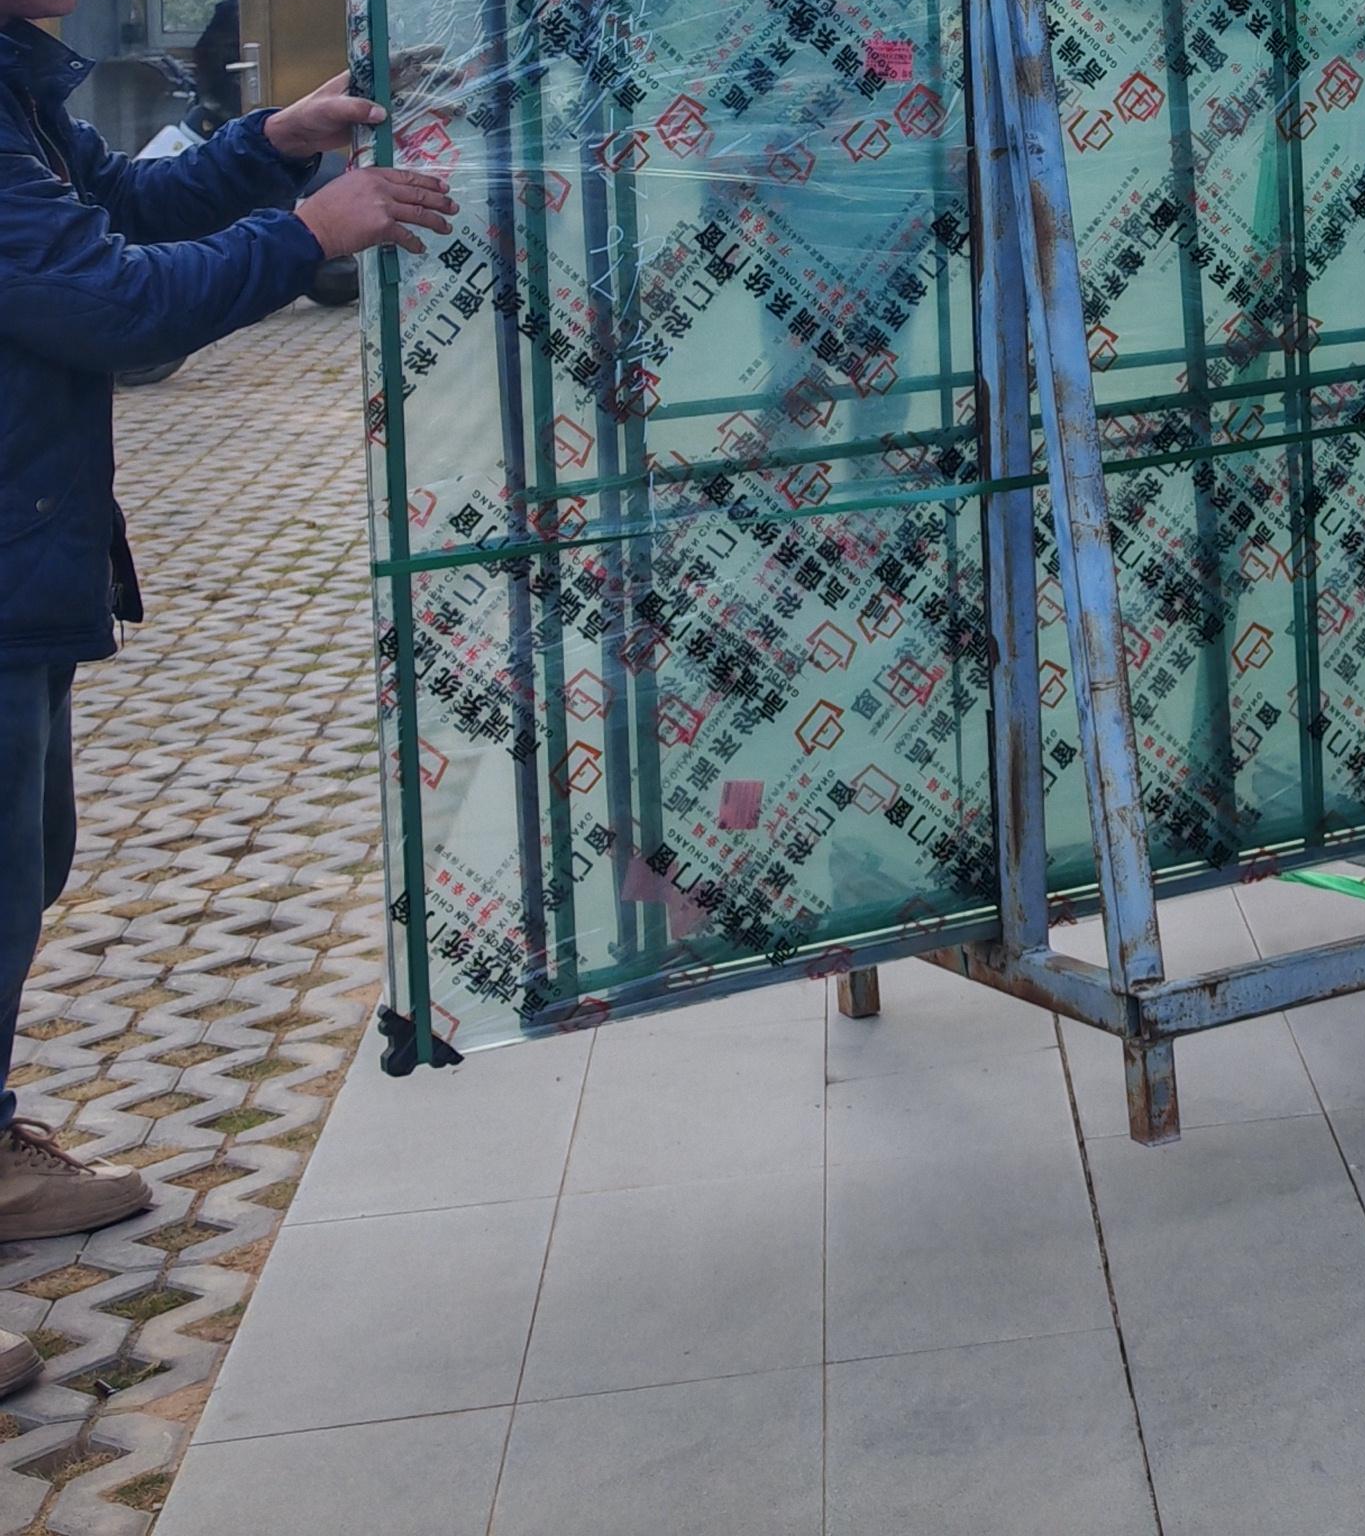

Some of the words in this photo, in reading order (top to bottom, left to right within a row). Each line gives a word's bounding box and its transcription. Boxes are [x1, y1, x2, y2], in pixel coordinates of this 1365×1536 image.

[435, 235, 603, 388] 高端系统门窗
[692, 218, 844, 364] 高端系统门窗
